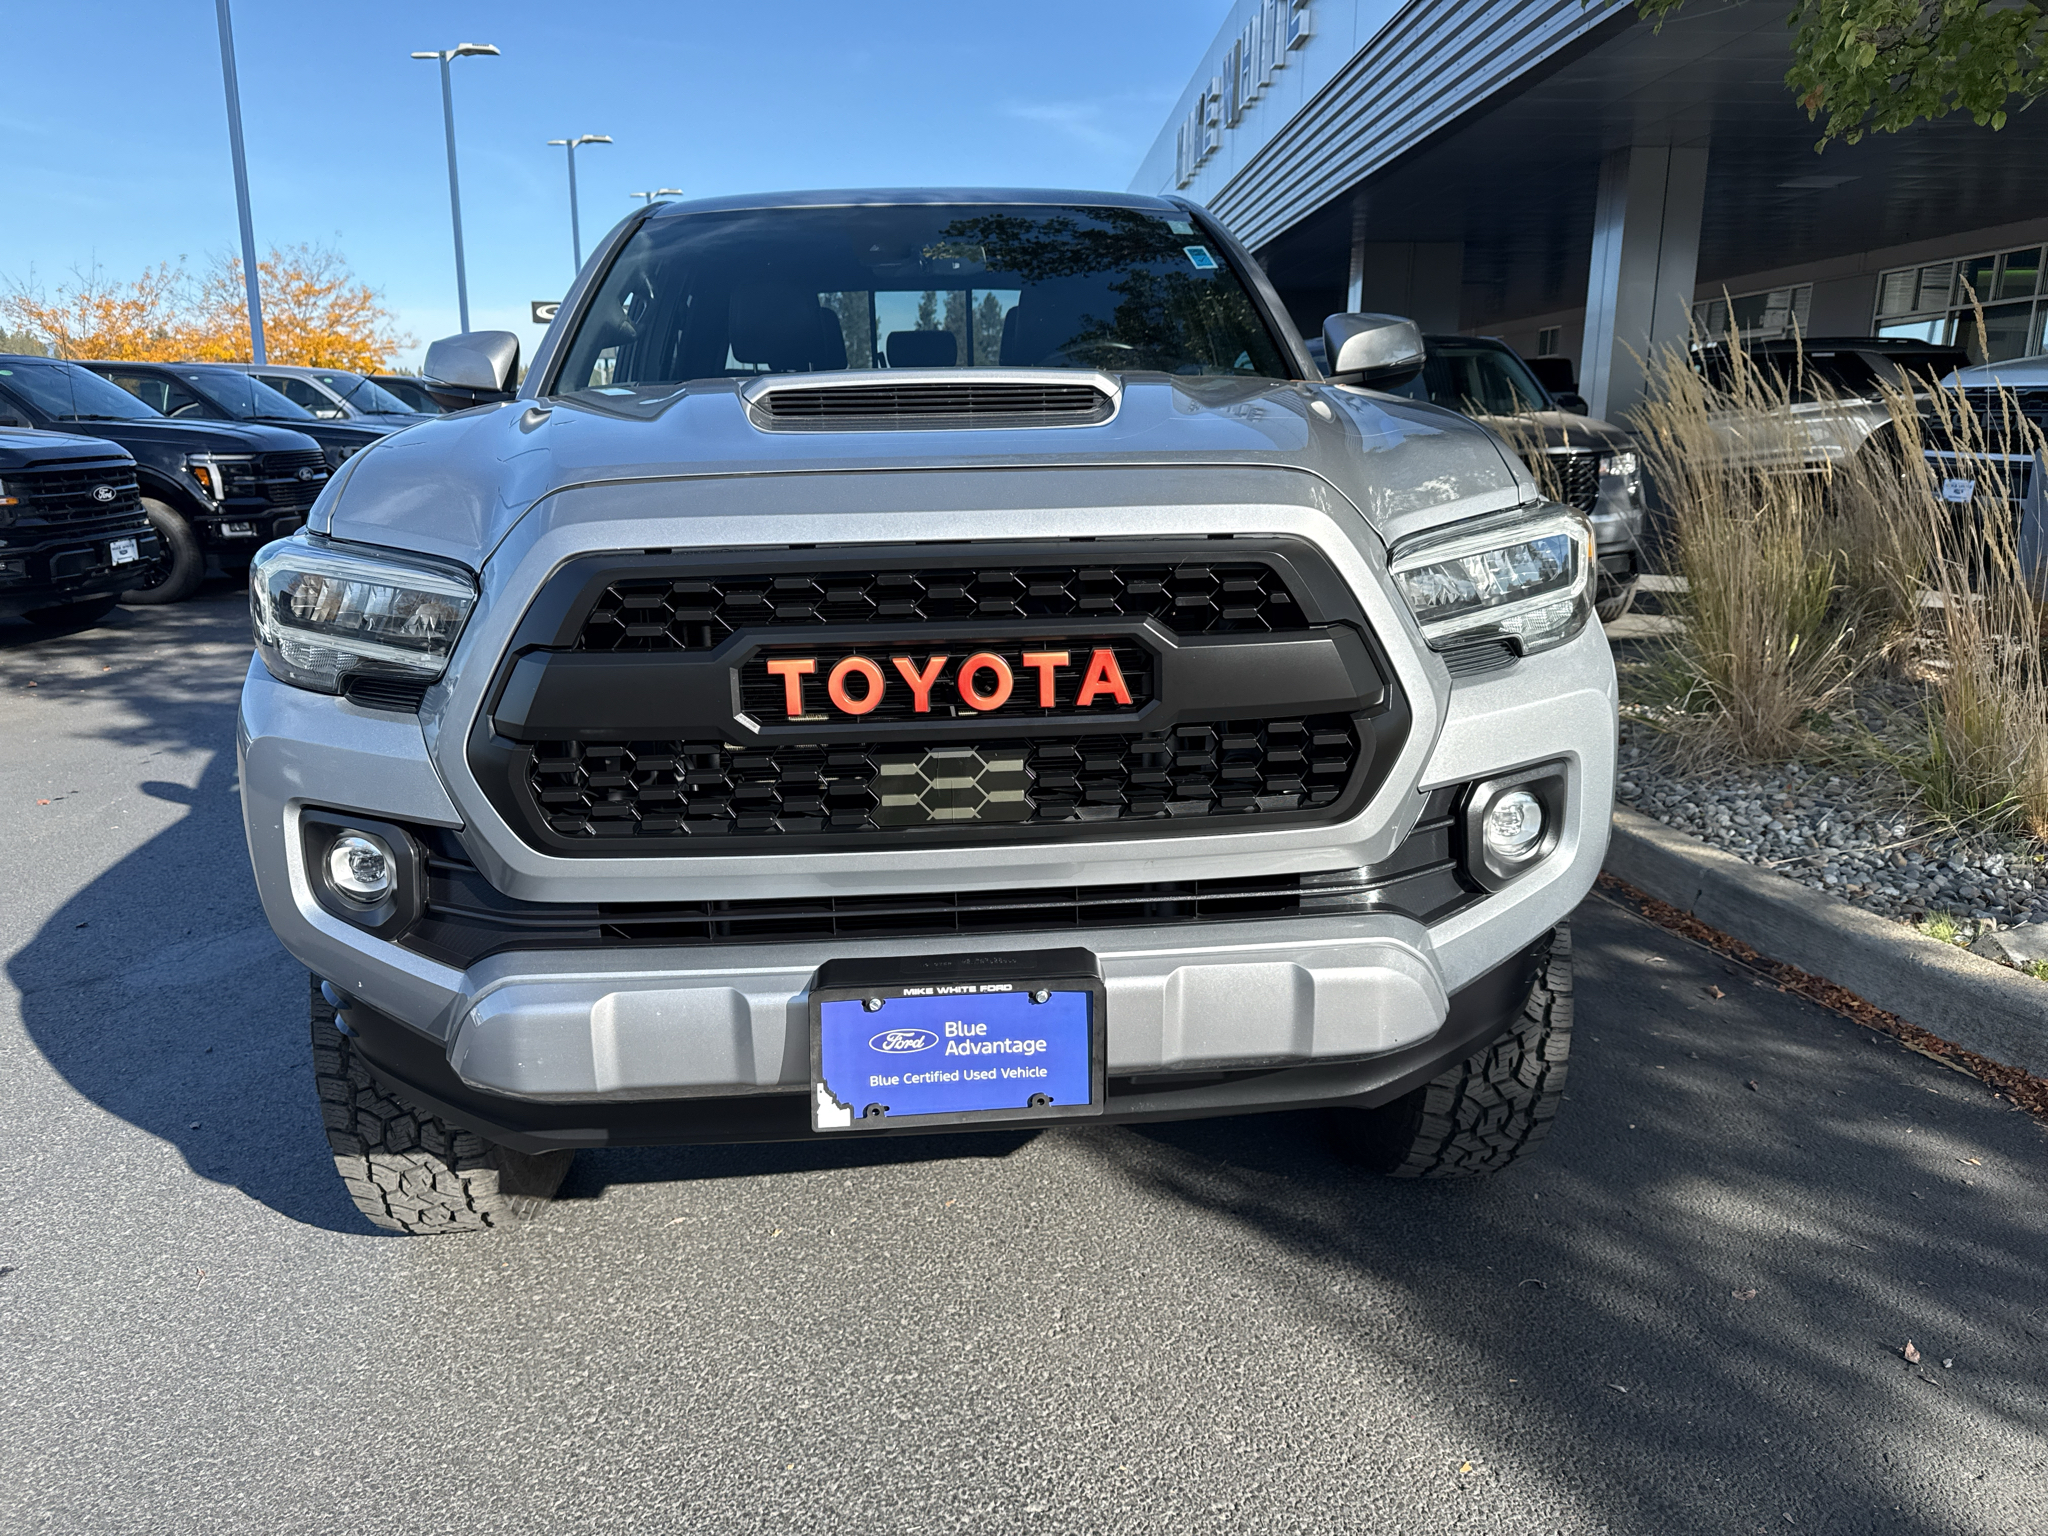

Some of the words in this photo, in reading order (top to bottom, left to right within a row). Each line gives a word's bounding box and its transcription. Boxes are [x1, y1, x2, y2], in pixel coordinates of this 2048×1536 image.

[767, 648, 1133, 716] TOYOTA
[903, 988, 934, 996] MIKE
[937, 986, 977, 994] WHITE
[980, 984, 1013, 993] FORD
[945, 1021, 987, 1037] Blue
[881, 1031, 926, 1051] Ford
[945, 1037, 1047, 1056] Advantage
[870, 1075, 900, 1087] Blue
[903, 1070, 960, 1085] Certified
[964, 1068, 997, 1081] Used
[1001, 1066, 1048, 1079] Vehicle
